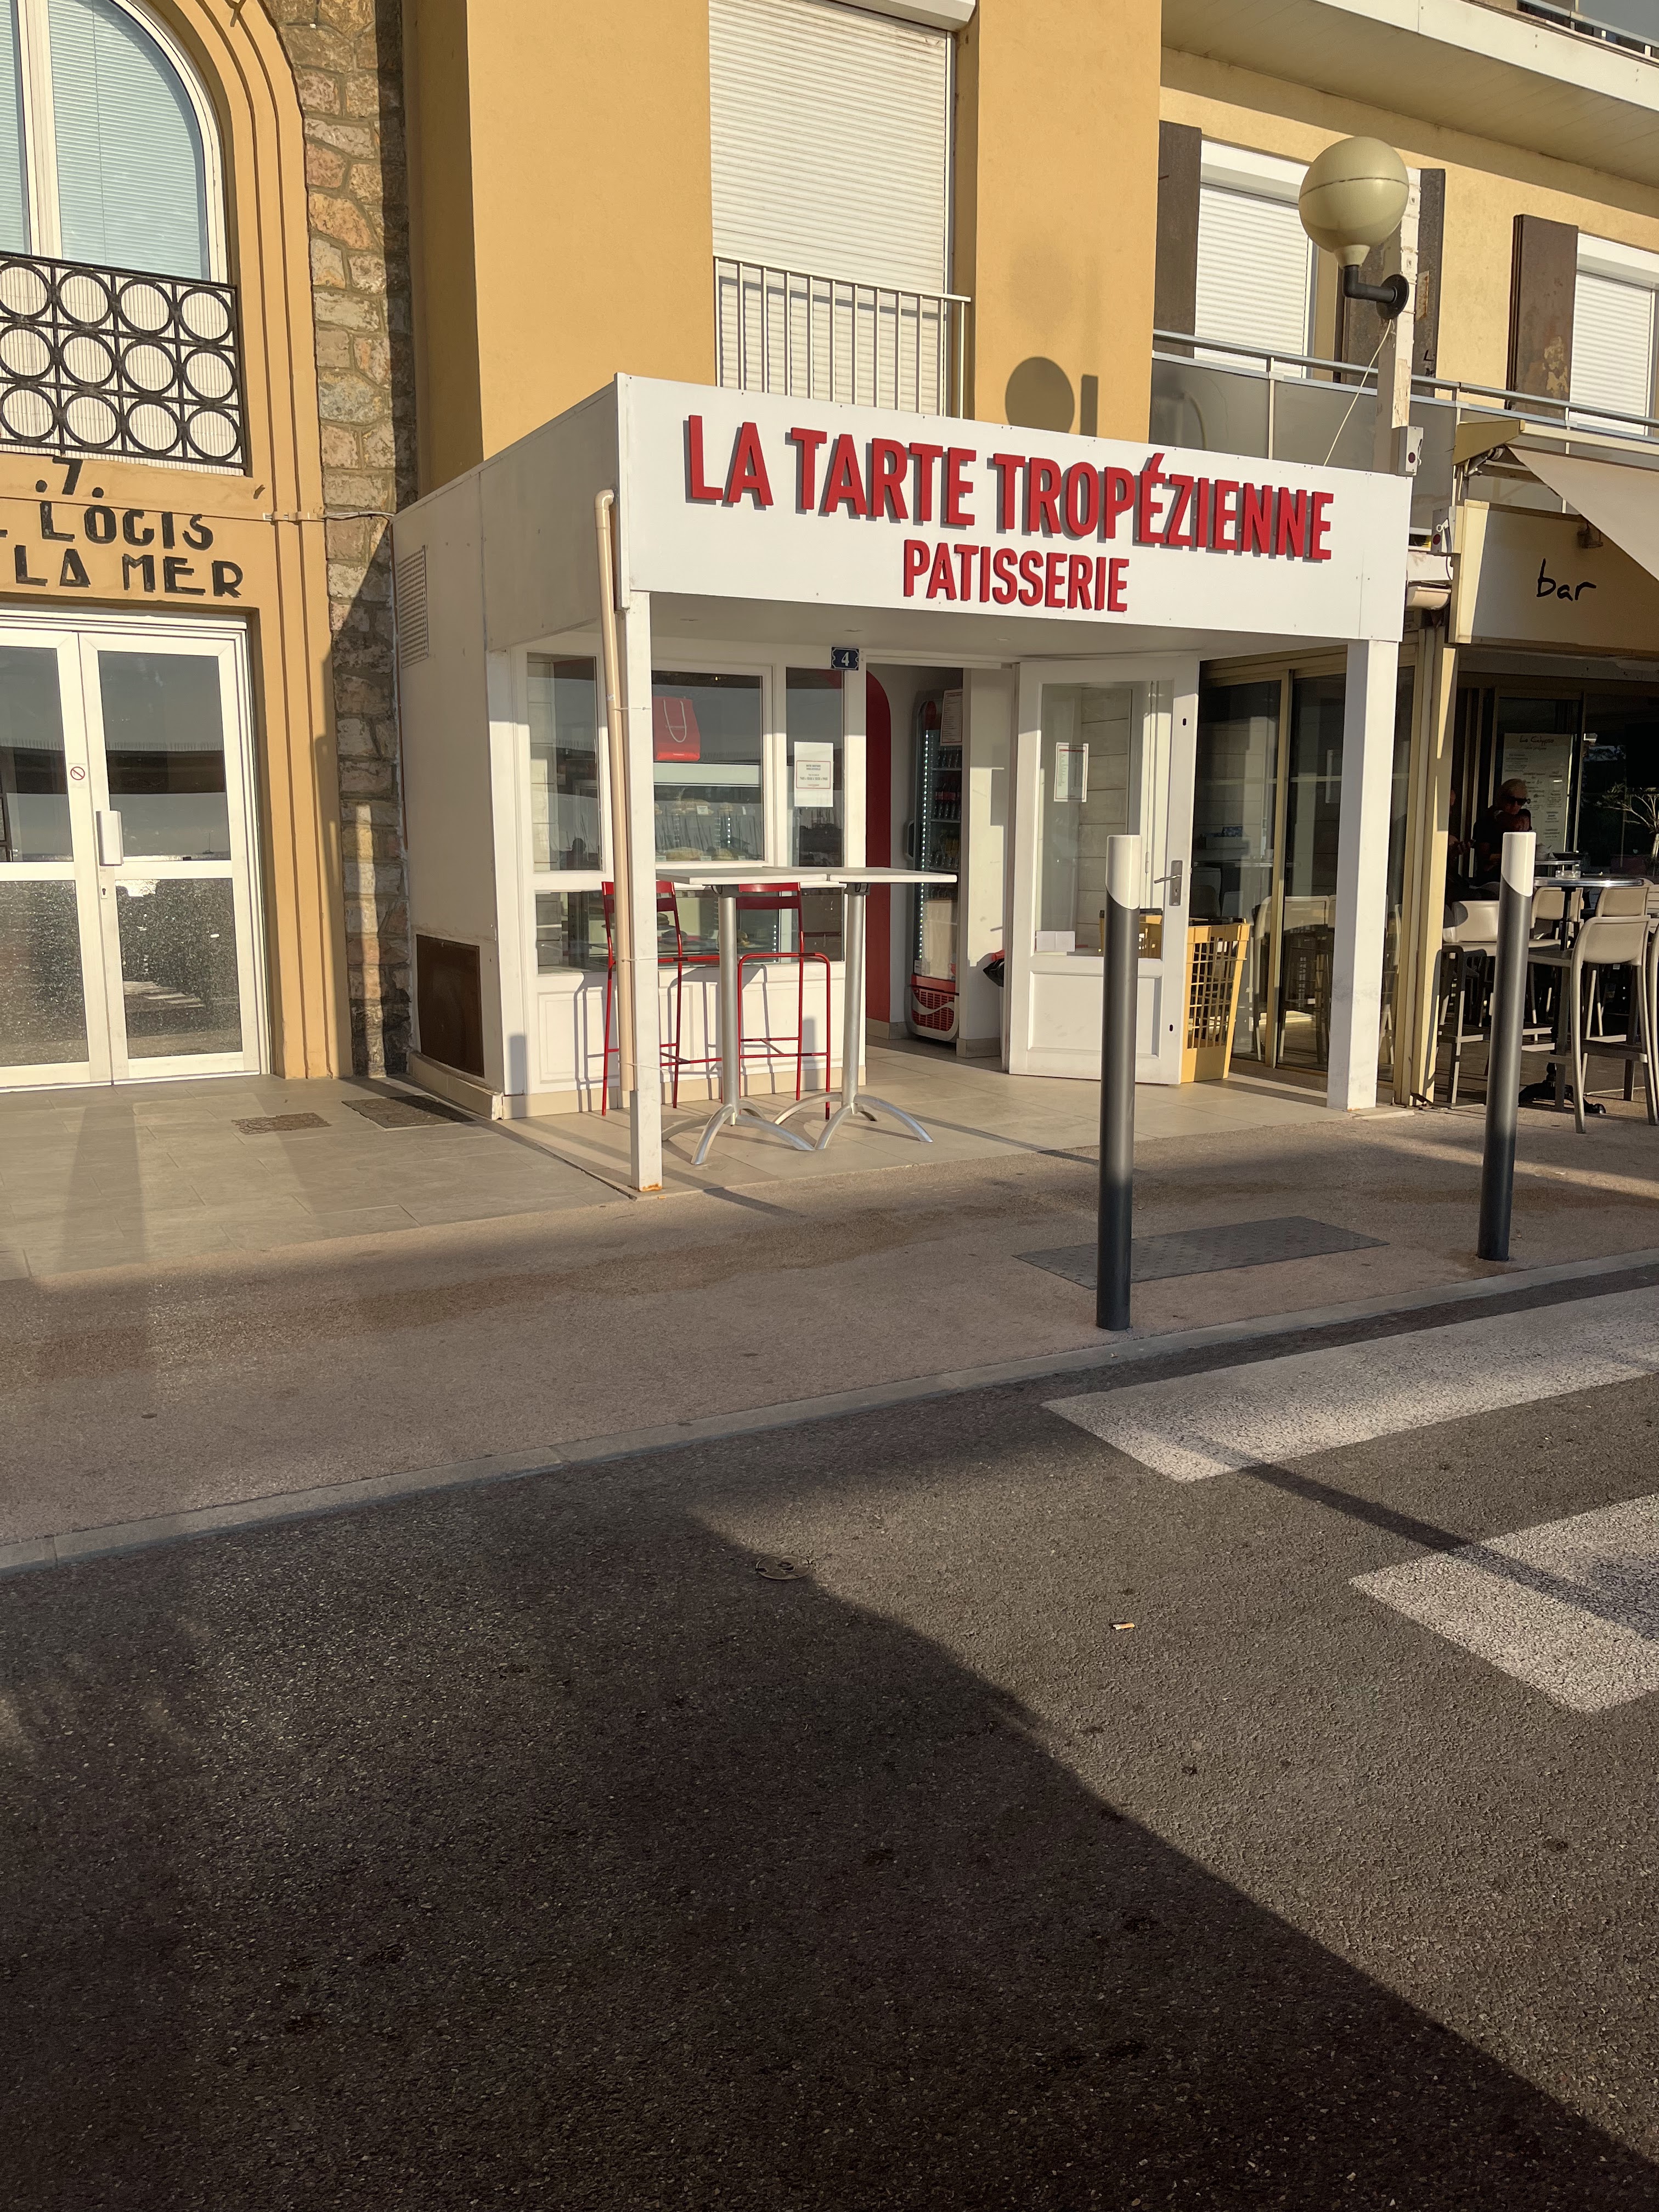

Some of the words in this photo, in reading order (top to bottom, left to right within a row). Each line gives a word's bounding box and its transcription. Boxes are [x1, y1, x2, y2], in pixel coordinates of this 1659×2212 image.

[688, 415, 774, 506] LA
[790, 427, 977, 526] TARTE
[994, 453, 1334, 560] TROPÉZIENNE
[40, 501, 213, 550] LOGIS
[14, 545, 91, 588] LA
[122, 553, 244, 598] MER
[904, 539, 1130, 612] PATISSERIE
[1536, 558, 1597, 602] bar
[841, 652, 850, 667] 4
